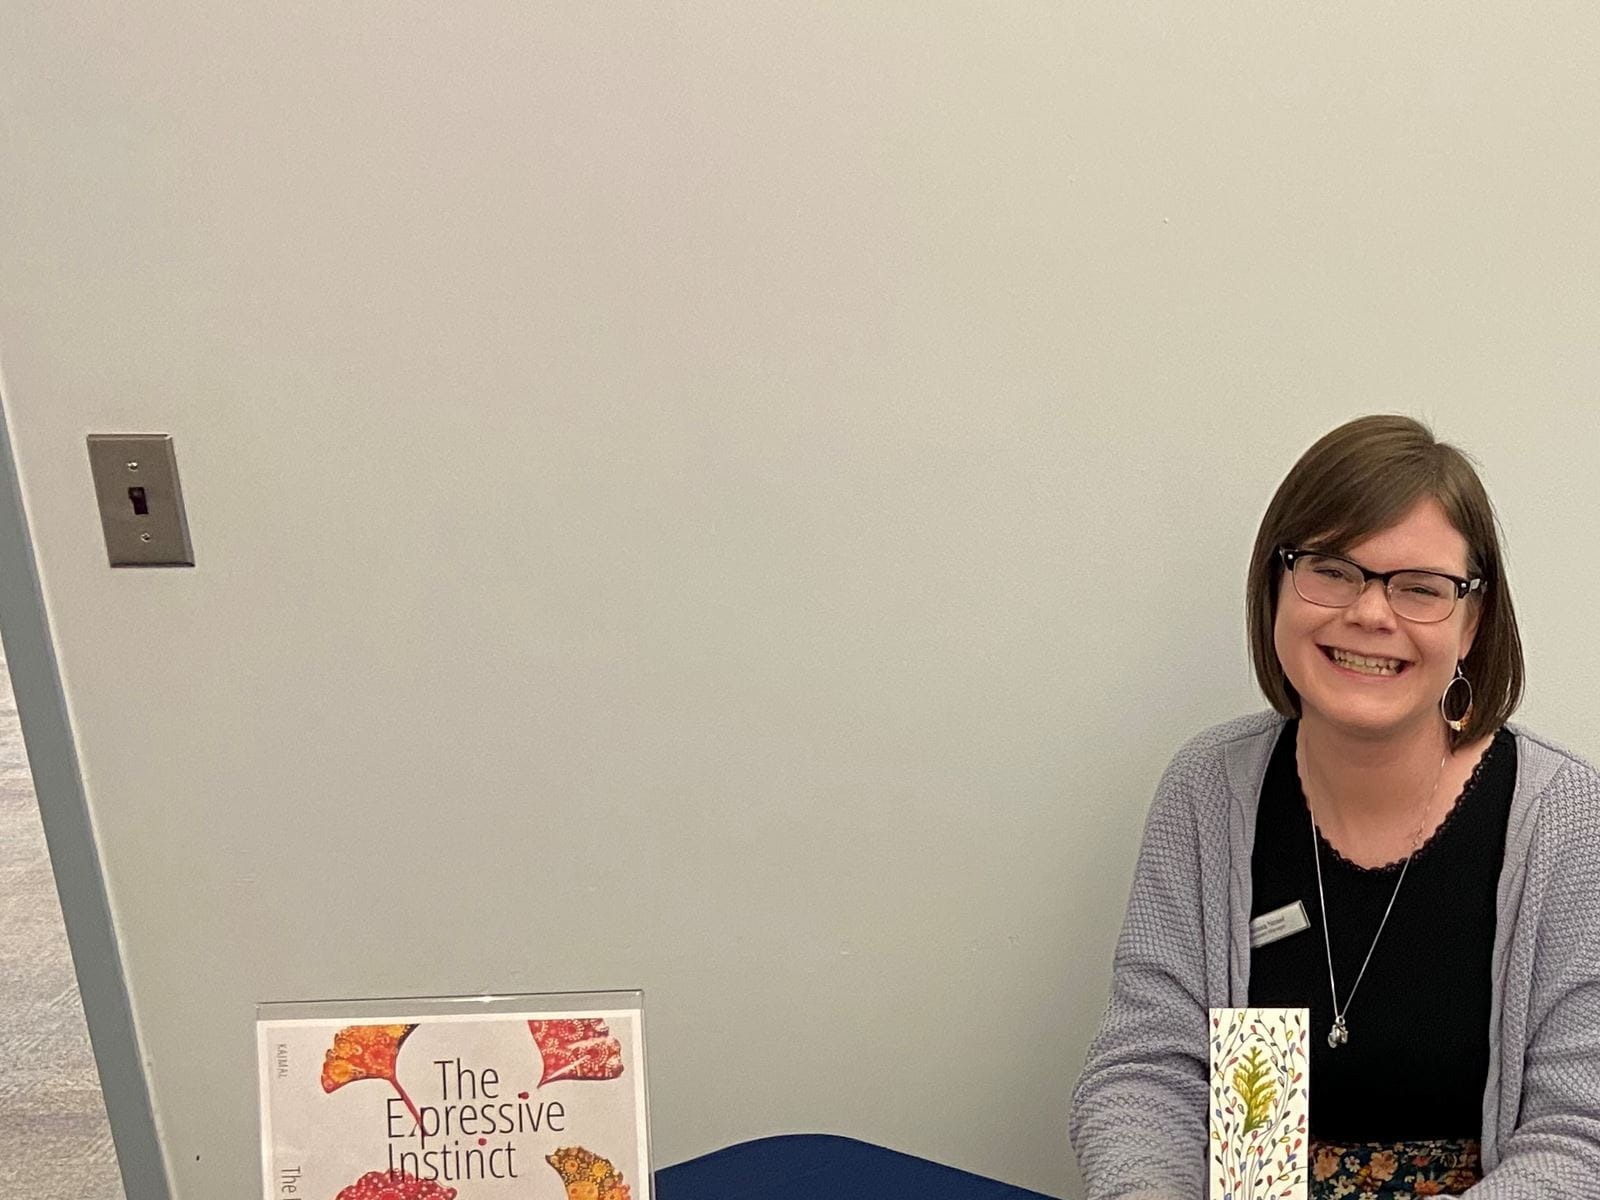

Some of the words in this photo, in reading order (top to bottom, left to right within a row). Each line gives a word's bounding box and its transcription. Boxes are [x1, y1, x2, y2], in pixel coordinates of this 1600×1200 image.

[278, 1044, 288, 1079] KAIMAL
[434, 1058, 499, 1100] The
[281, 1166, 301, 1193] The
[389, 1139, 518, 1182] Instinct
